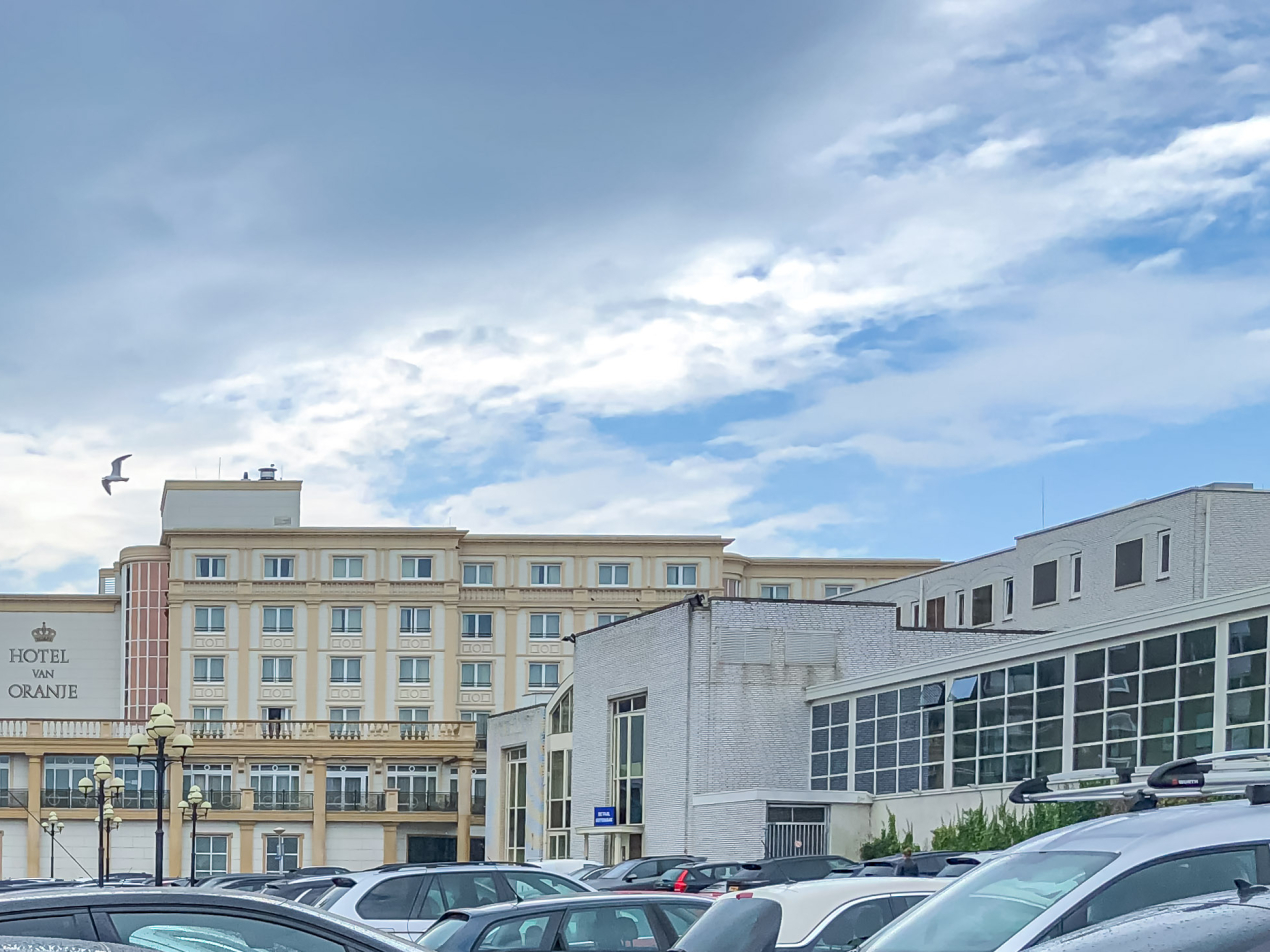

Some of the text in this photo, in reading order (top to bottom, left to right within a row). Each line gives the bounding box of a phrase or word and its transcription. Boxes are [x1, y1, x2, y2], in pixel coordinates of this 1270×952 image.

[9, 648, 70, 664] HOTEL
[32, 668, 55, 679] VAN
[8, 683, 78, 699] ORANJE
